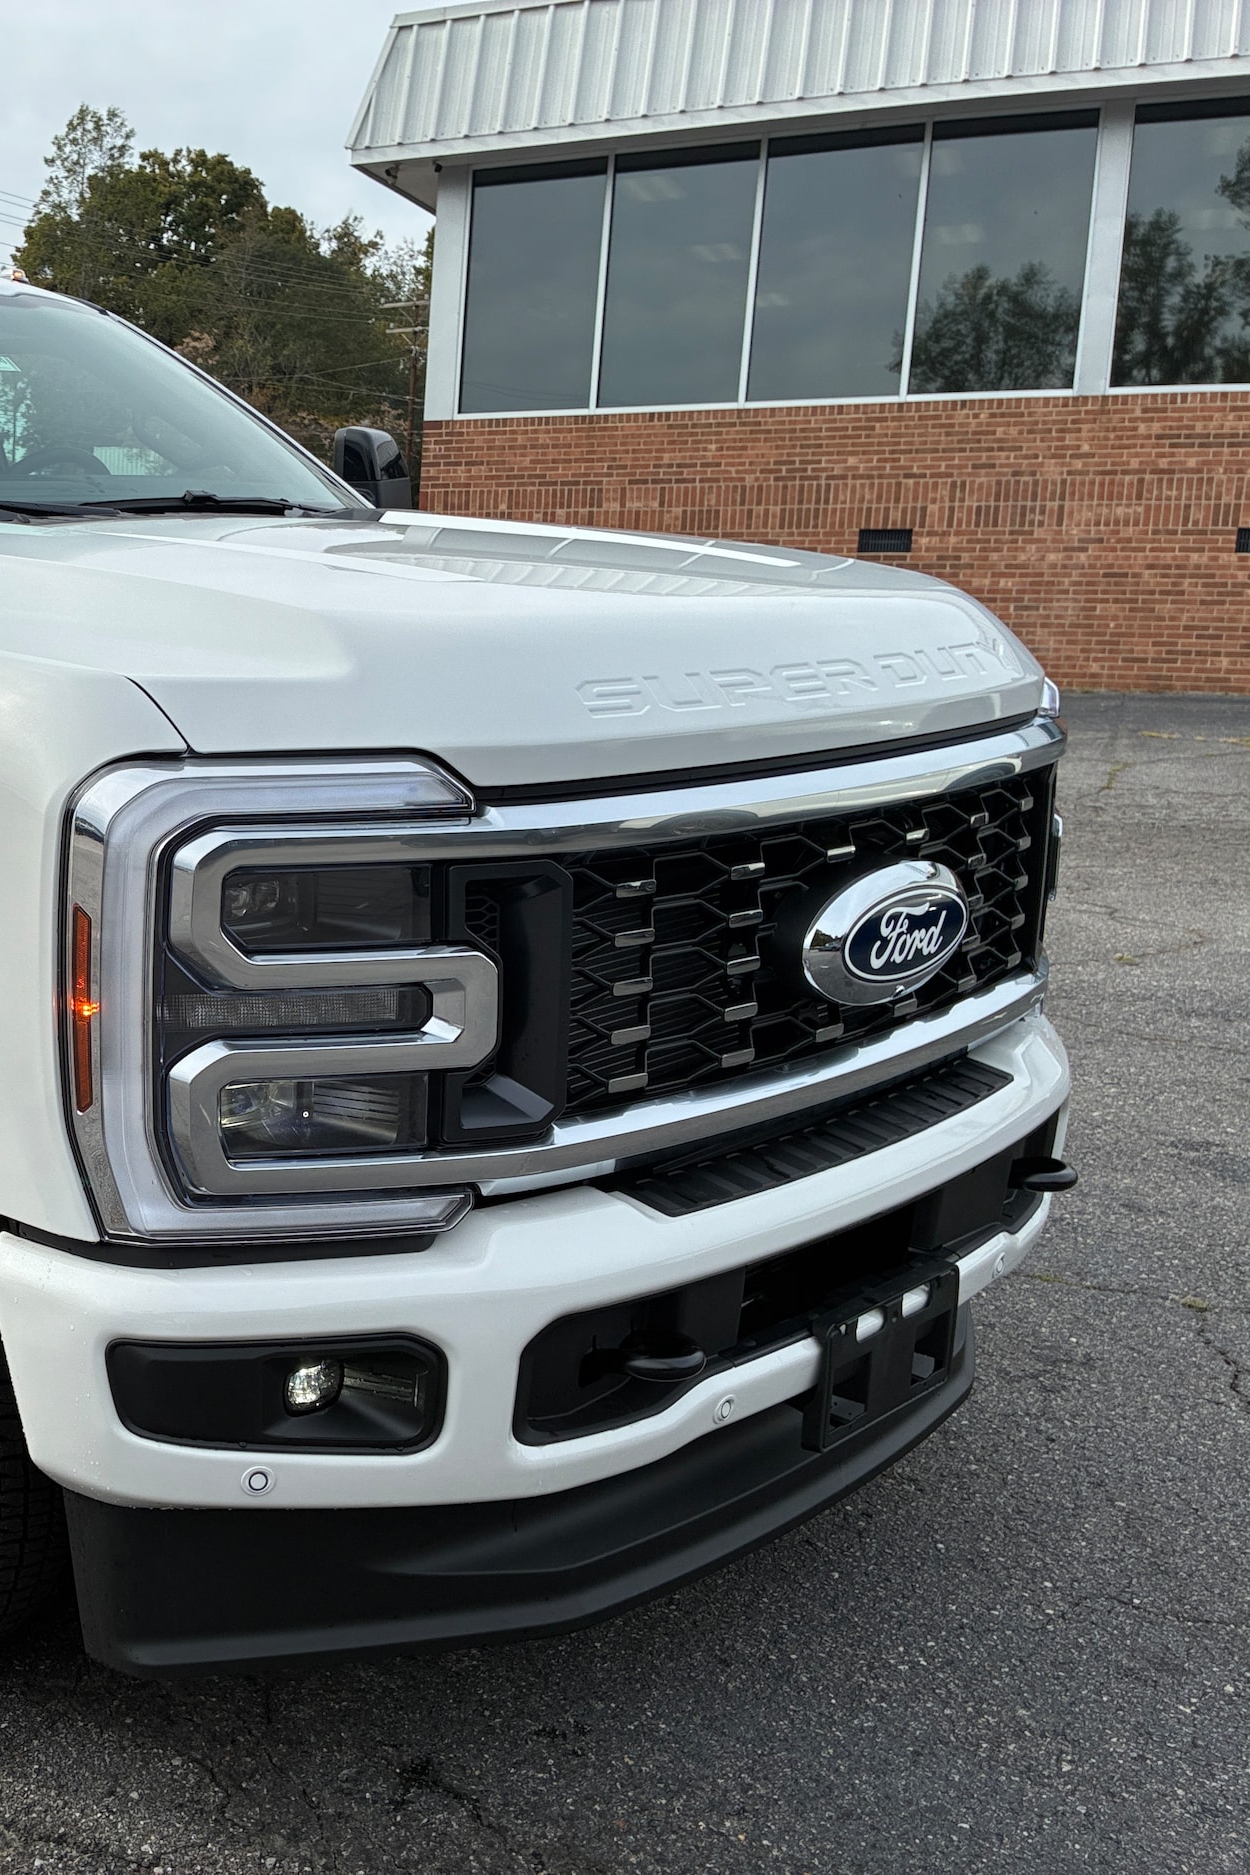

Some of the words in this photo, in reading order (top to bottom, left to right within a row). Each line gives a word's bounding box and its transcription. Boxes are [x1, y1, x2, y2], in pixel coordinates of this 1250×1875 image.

[575, 657, 879, 719] SUPER
[873, 638, 1016, 689] DUTY
[869, 902, 947, 970] Ford
